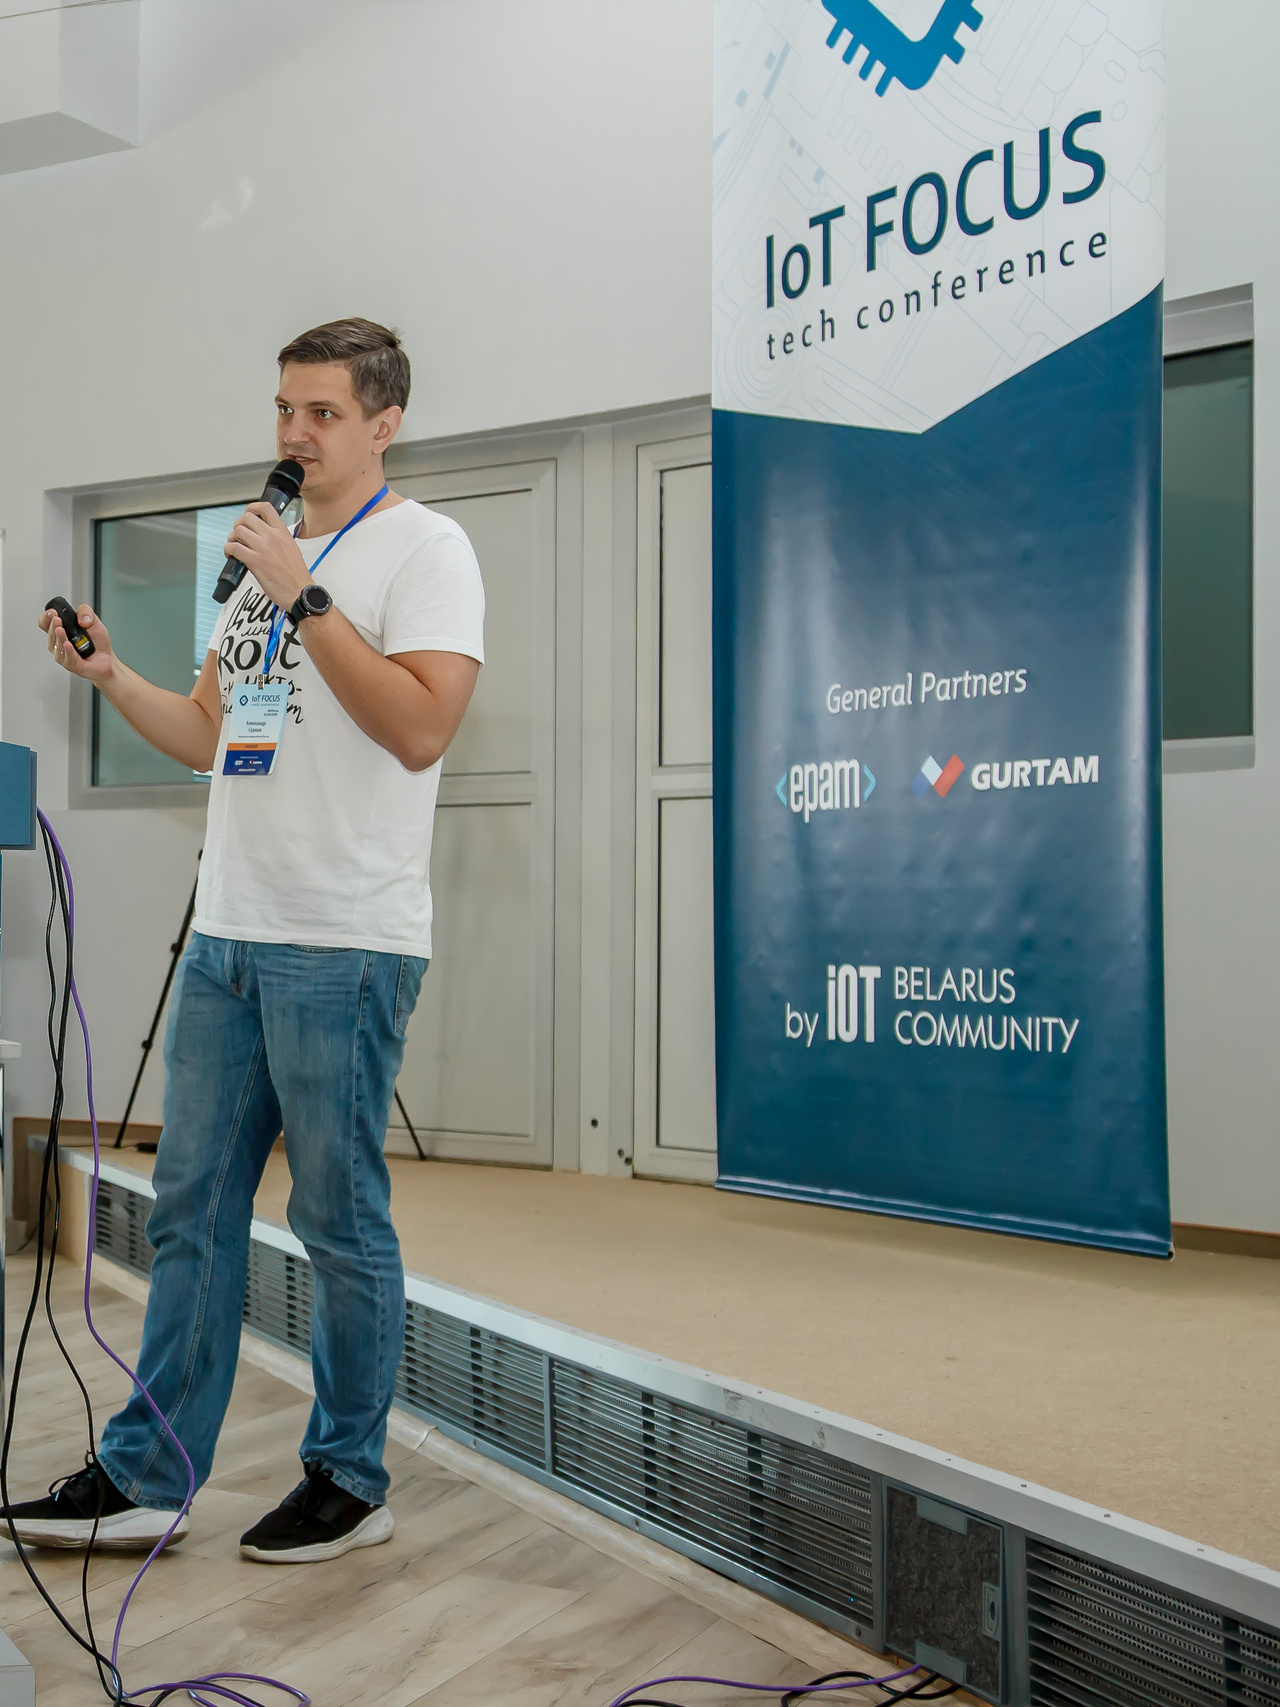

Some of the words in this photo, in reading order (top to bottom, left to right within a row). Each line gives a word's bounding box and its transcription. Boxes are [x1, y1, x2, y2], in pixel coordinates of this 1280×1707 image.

[766, 205, 845, 308] IoT
[866, 110, 1106, 272] FOCUS
[767, 310, 835, 361] tech
[856, 231, 1107, 330] conference
[826, 673, 913, 714] General
[921, 667, 1027, 703] Partners
[970, 754, 1099, 791] GURTAM
[894, 966, 1016, 1004] BELARUS
[785, 1002, 818, 1047] by
[894, 1009, 1080, 1054] COMMUNITY
